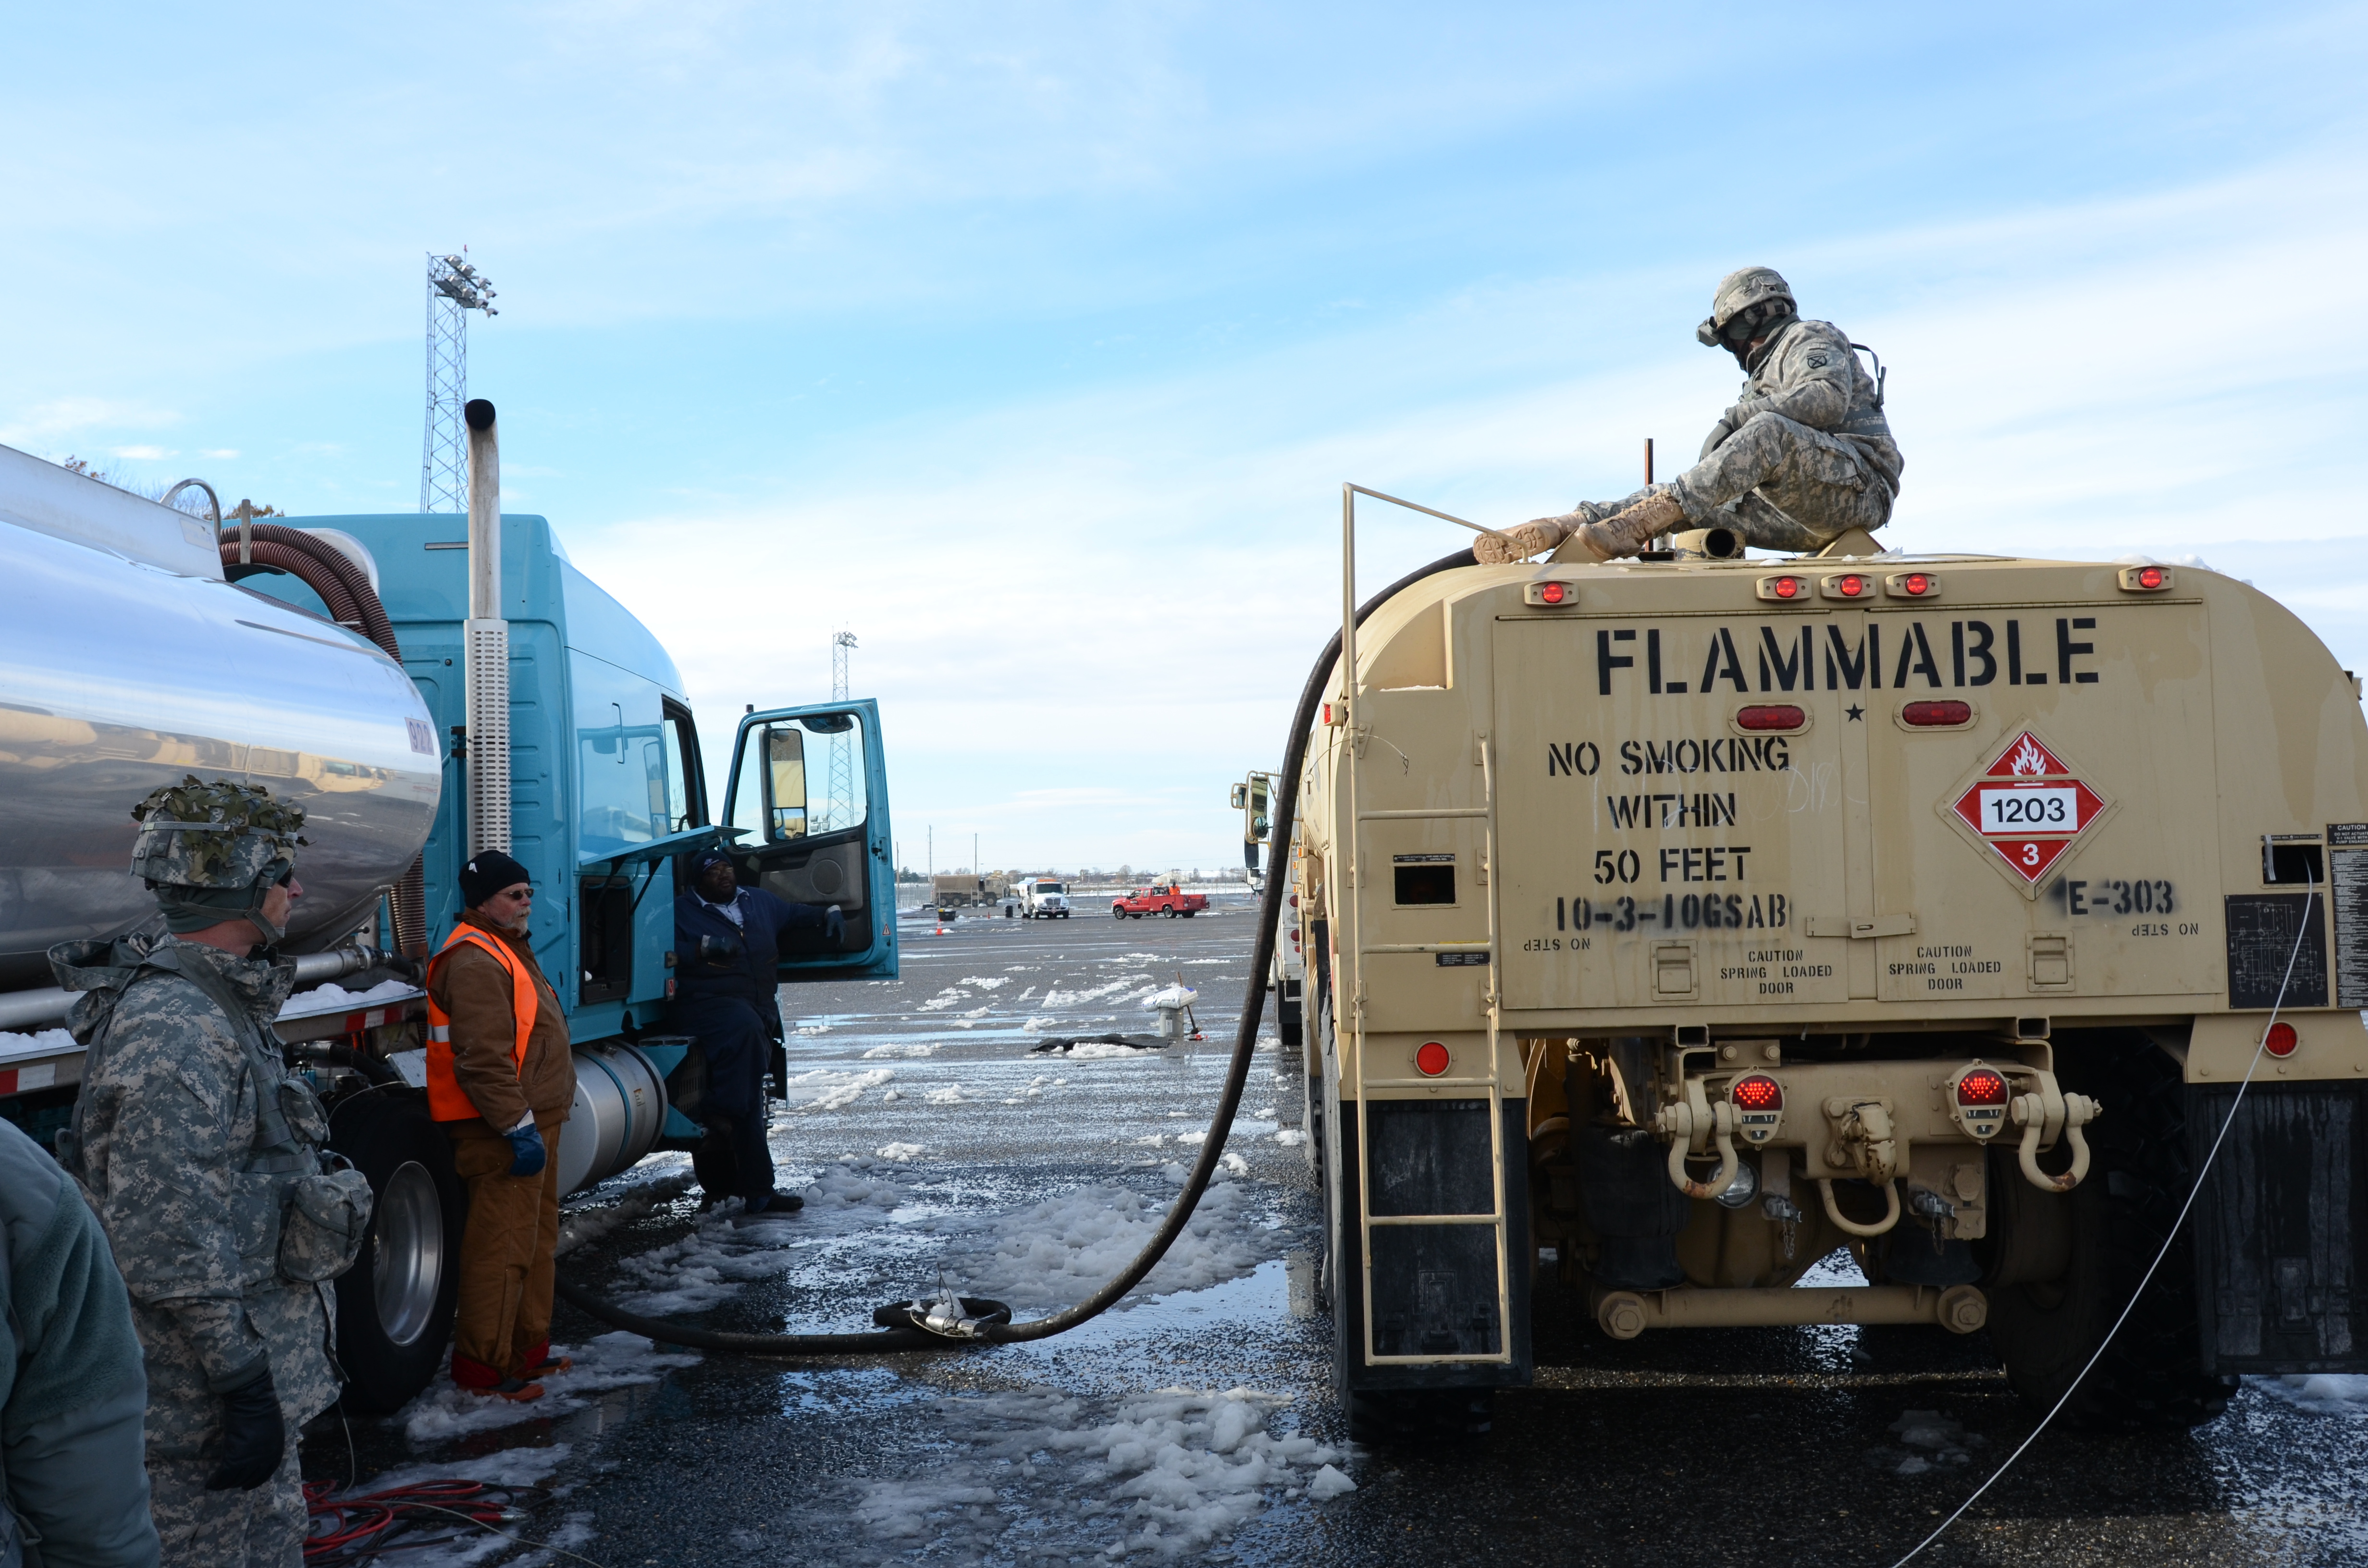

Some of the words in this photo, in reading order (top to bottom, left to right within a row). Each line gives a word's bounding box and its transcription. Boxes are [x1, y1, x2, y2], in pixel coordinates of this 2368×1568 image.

[1598, 618, 2098, 695] FLAMMABLE
[409, 721, 432, 752] 922
[1549, 742, 1600, 776] NO
[1620, 736, 1789, 775] SMOKING
[1607, 793, 1736, 829] WITHIN
[1991, 797, 2065, 822] 1203
[2023, 844, 2039, 865] 3
[1594, 849, 1640, 884] 50
[1660, 846, 1751, 882] FEET
[2069, 880, 2173, 915] E-303
[2132, 924, 2169, 936] STEP
[2179, 923, 2199, 935] NO
[1524, 939, 1561, 951] STEP
[1570, 938, 1591, 950] NO
[1748, 950, 1803, 962] CAUTION
[1917, 945, 1972, 958] CAUTION
[1721, 967, 1767, 980] SPRING
[1783, 965, 1832, 978] LOADED
[1889, 963, 1936, 975] SPRING
[1952, 961, 2001, 974] LOADED
[1759, 982, 1794, 994] DOOR
[1928, 978, 1963, 990] DOOR
